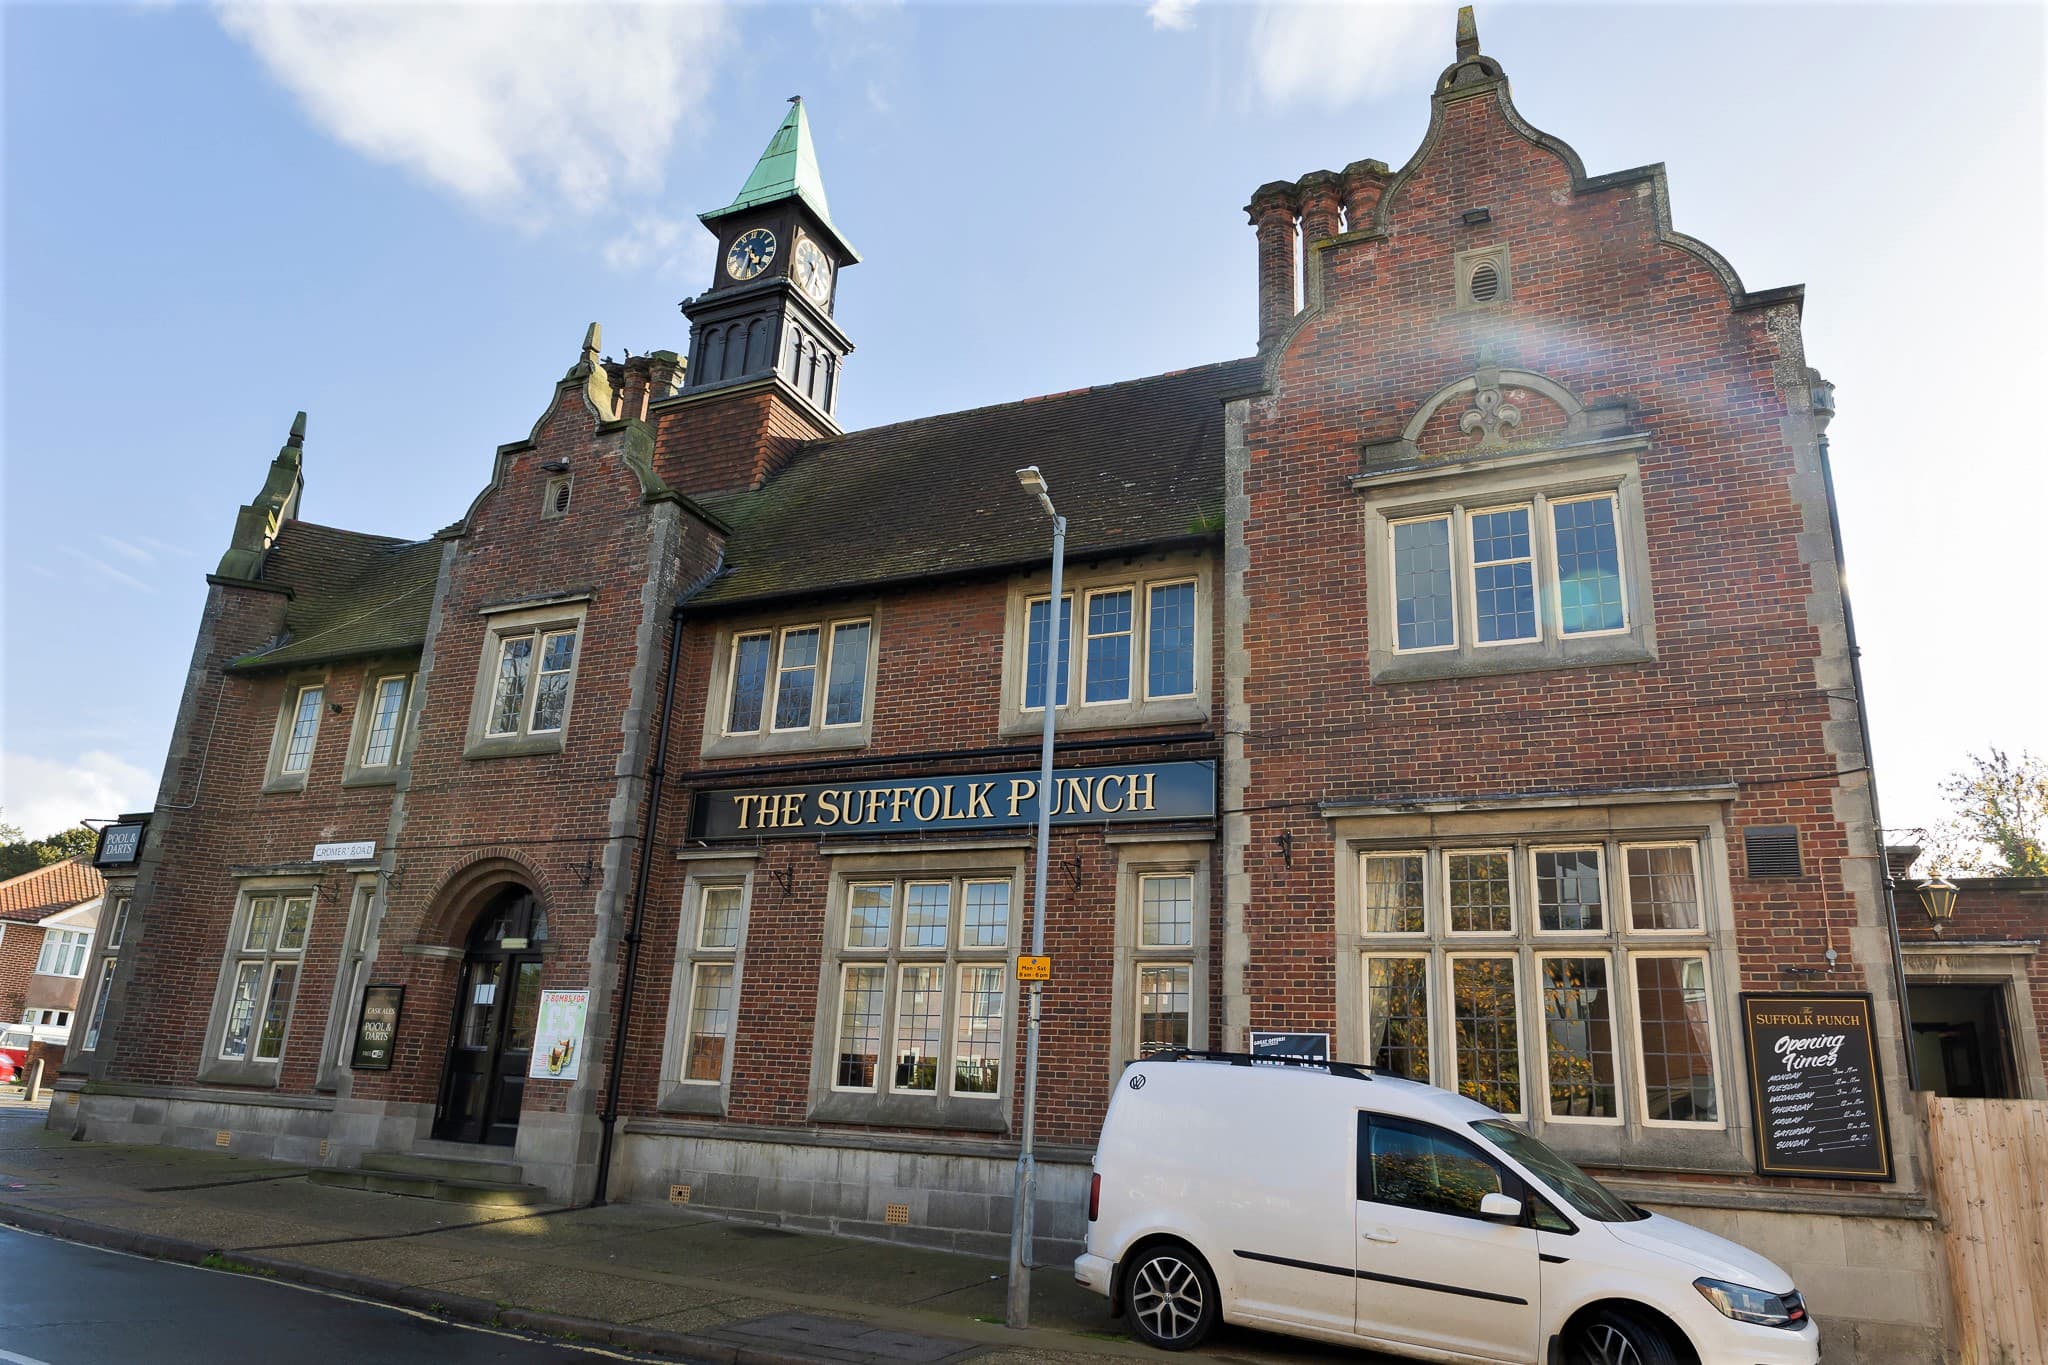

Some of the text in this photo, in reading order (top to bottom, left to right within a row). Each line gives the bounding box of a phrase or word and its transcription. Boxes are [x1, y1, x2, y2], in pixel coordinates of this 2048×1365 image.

[733, 773, 1157, 831] THE SUFFOLK PUNCH
[106, 833, 136, 844] POOL &
[106, 844, 132, 854] DARTS
[350, 845, 373, 856] ROAD
[550, 994, 572, 1003] BOMBS
[573, 994, 586, 1003] FOR
[1756, 1014, 1860, 1026] SUFFOLK PUNCH
[365, 1022, 392, 1031] POOL &
[365, 1032, 388, 1040] DARTS
[1774, 1034, 1845, 1055] Opening
[1782, 1053, 1838, 1072] Times
[1767, 1072, 1803, 1082] MONDAY
[1767, 1082, 1803, 1093] TUESDAY
[1769, 1091, 1815, 1103] WEDNESDAY
[1771, 1103, 1814, 1114] THURSDAY
[1773, 1126, 1816, 1138] SATURDAY
[1776, 1138, 1810, 1150] SUNDAY
